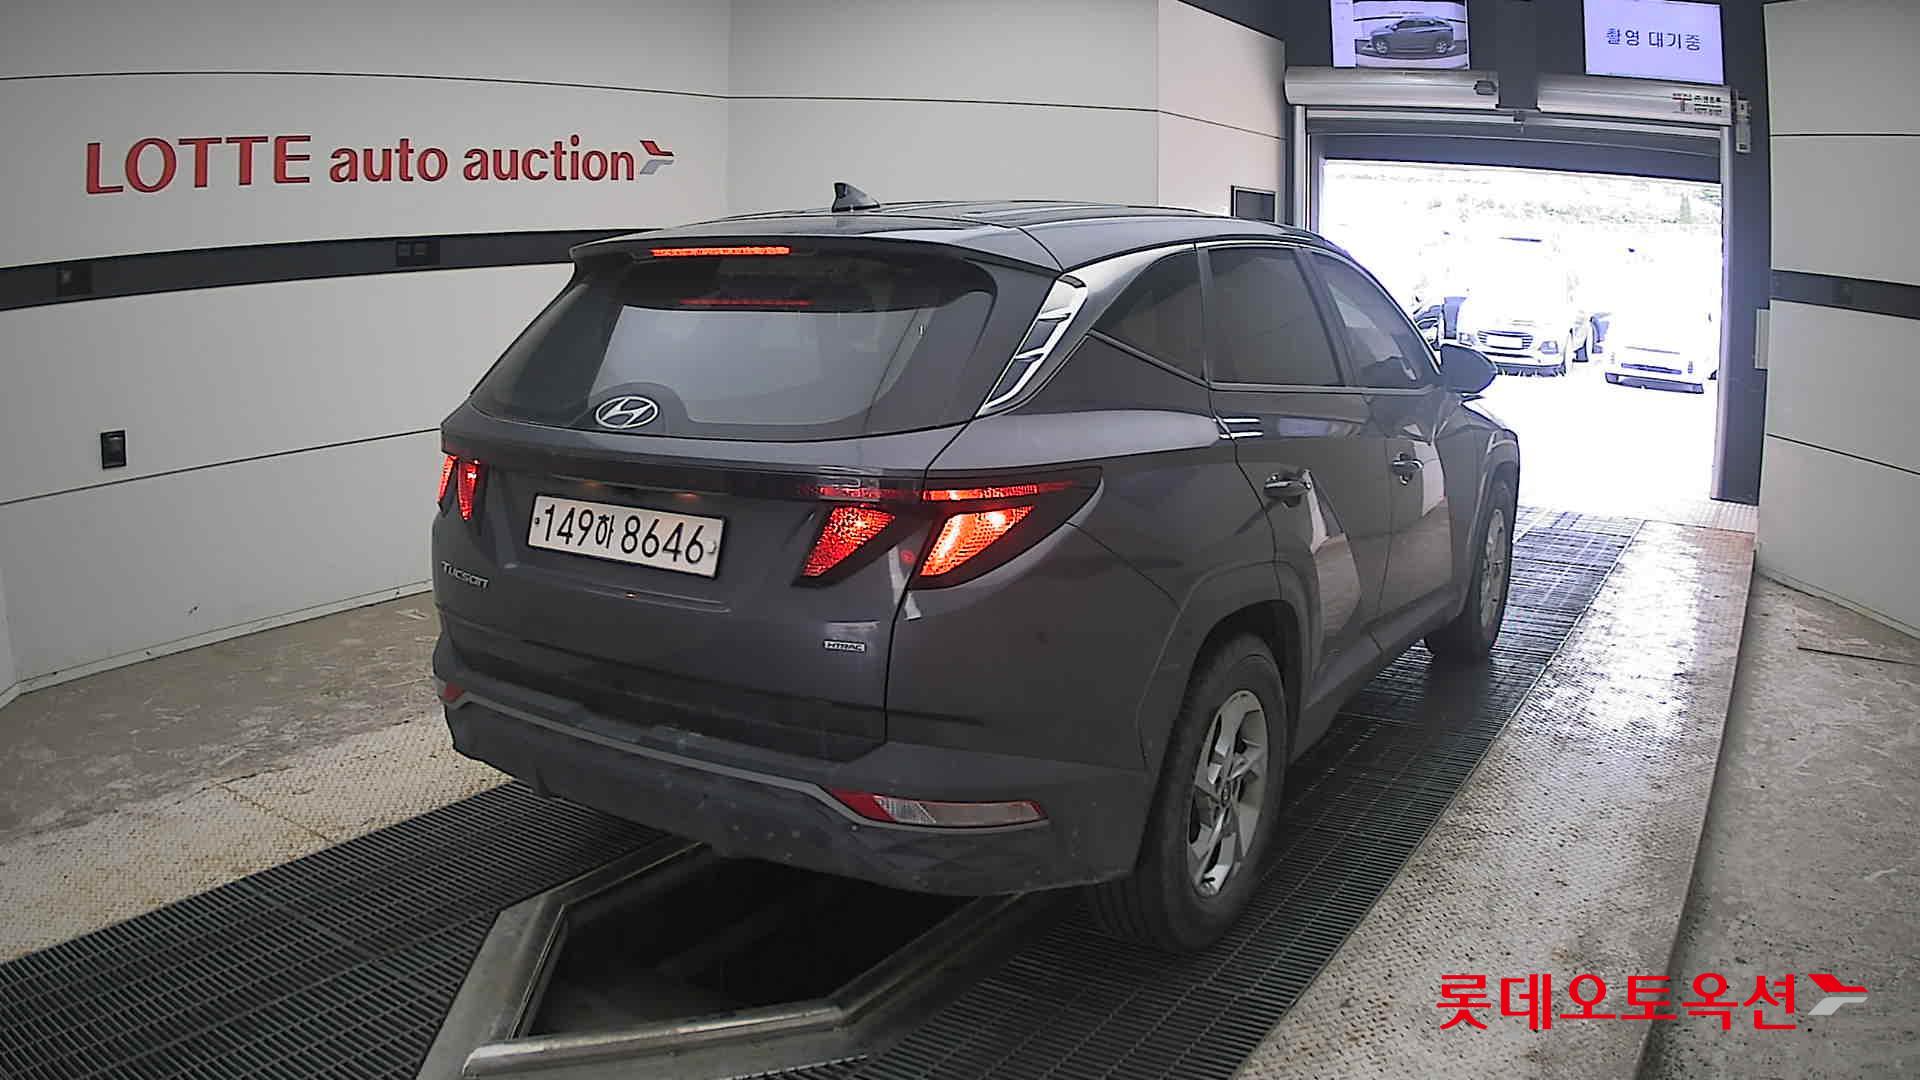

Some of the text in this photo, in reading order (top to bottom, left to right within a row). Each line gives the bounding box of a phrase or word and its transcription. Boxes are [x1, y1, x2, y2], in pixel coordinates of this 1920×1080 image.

[1606, 27, 1701, 52] 촬영 대기중
[86, 135, 636, 195] LOTTE auto auction
[544, 503, 705, 565] 149하 8646
